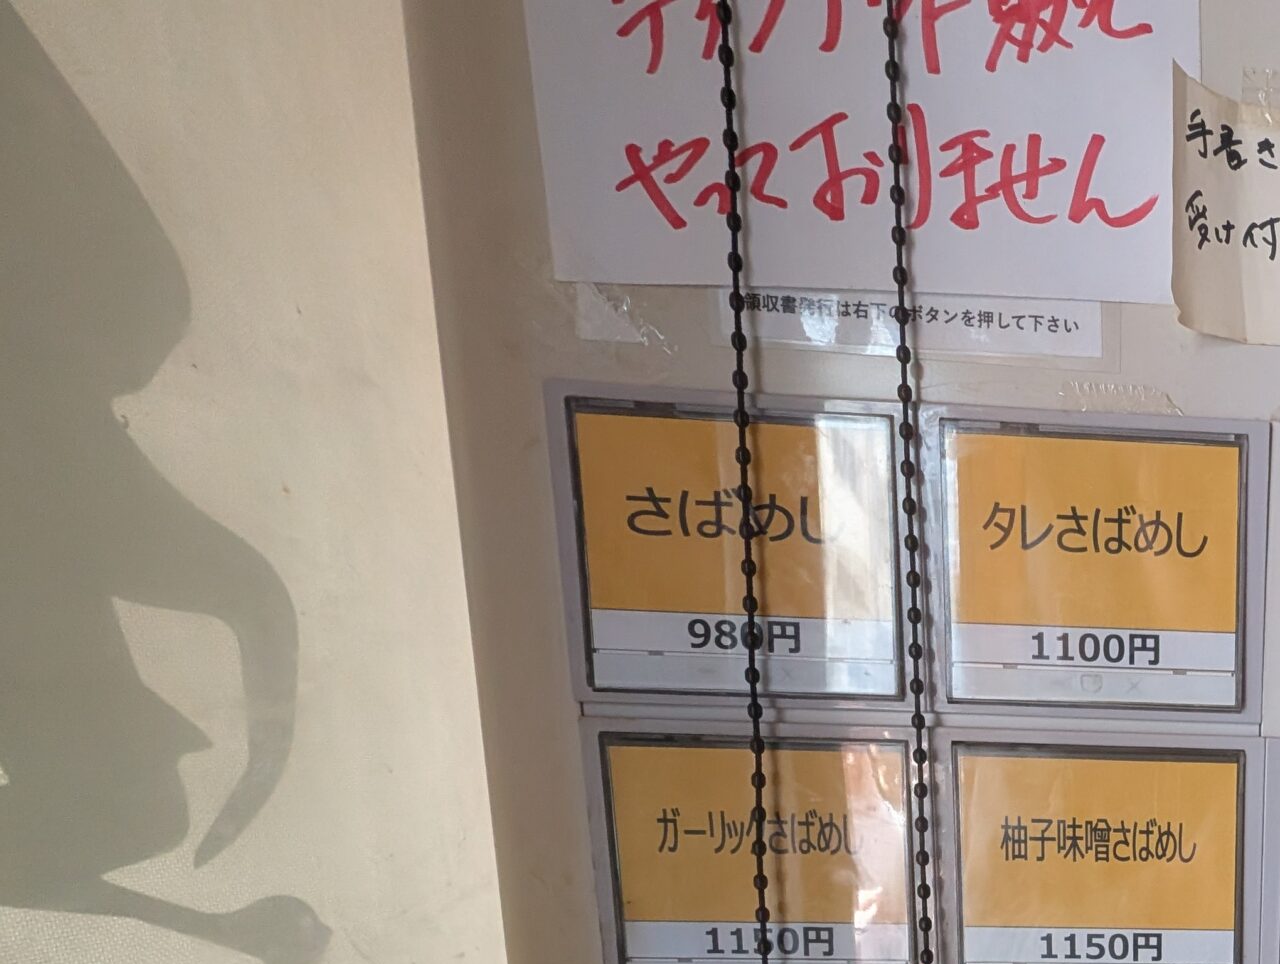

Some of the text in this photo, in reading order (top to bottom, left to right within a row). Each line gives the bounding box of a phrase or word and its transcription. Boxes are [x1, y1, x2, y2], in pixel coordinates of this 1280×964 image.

[625, 486, 834, 545] さばめし
[982, 502, 1209, 558] タレさばめし
[687, 618, 801, 654] 980円
[1031, 632, 1160, 665] 1100円
[1000, 816, 1197, 864] 柚子味噌さばめし
[1040, 932, 1163, 962] 1150円
